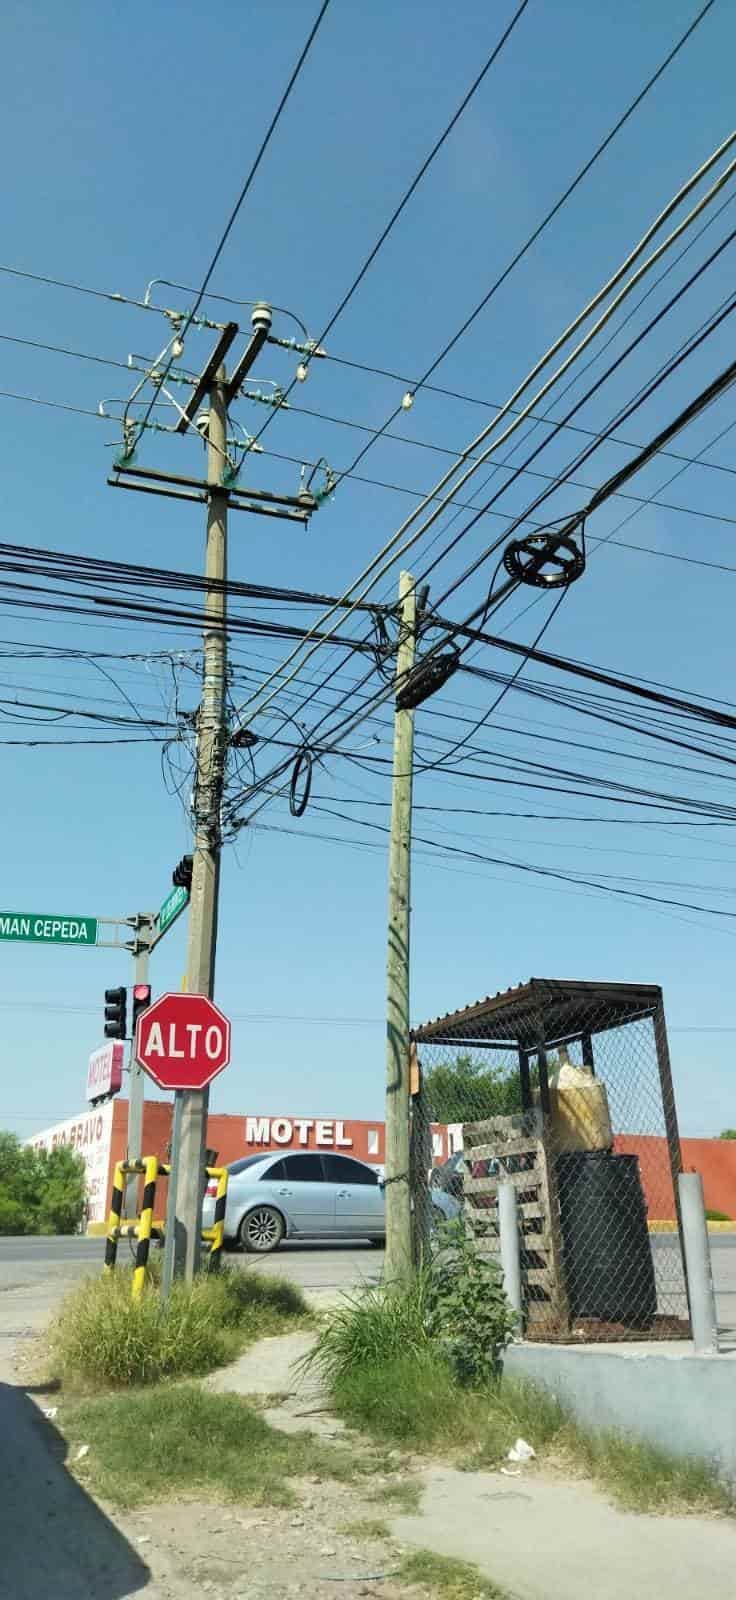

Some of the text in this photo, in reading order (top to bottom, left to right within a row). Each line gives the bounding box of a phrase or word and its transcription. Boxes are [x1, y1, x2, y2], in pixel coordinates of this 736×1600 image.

[34, 919, 88, 939] CEPEDA
[144, 1022, 223, 1060] ALTO
[70, 1114, 103, 1148] BRAVO
[245, 1117, 353, 1146] MOTEL
